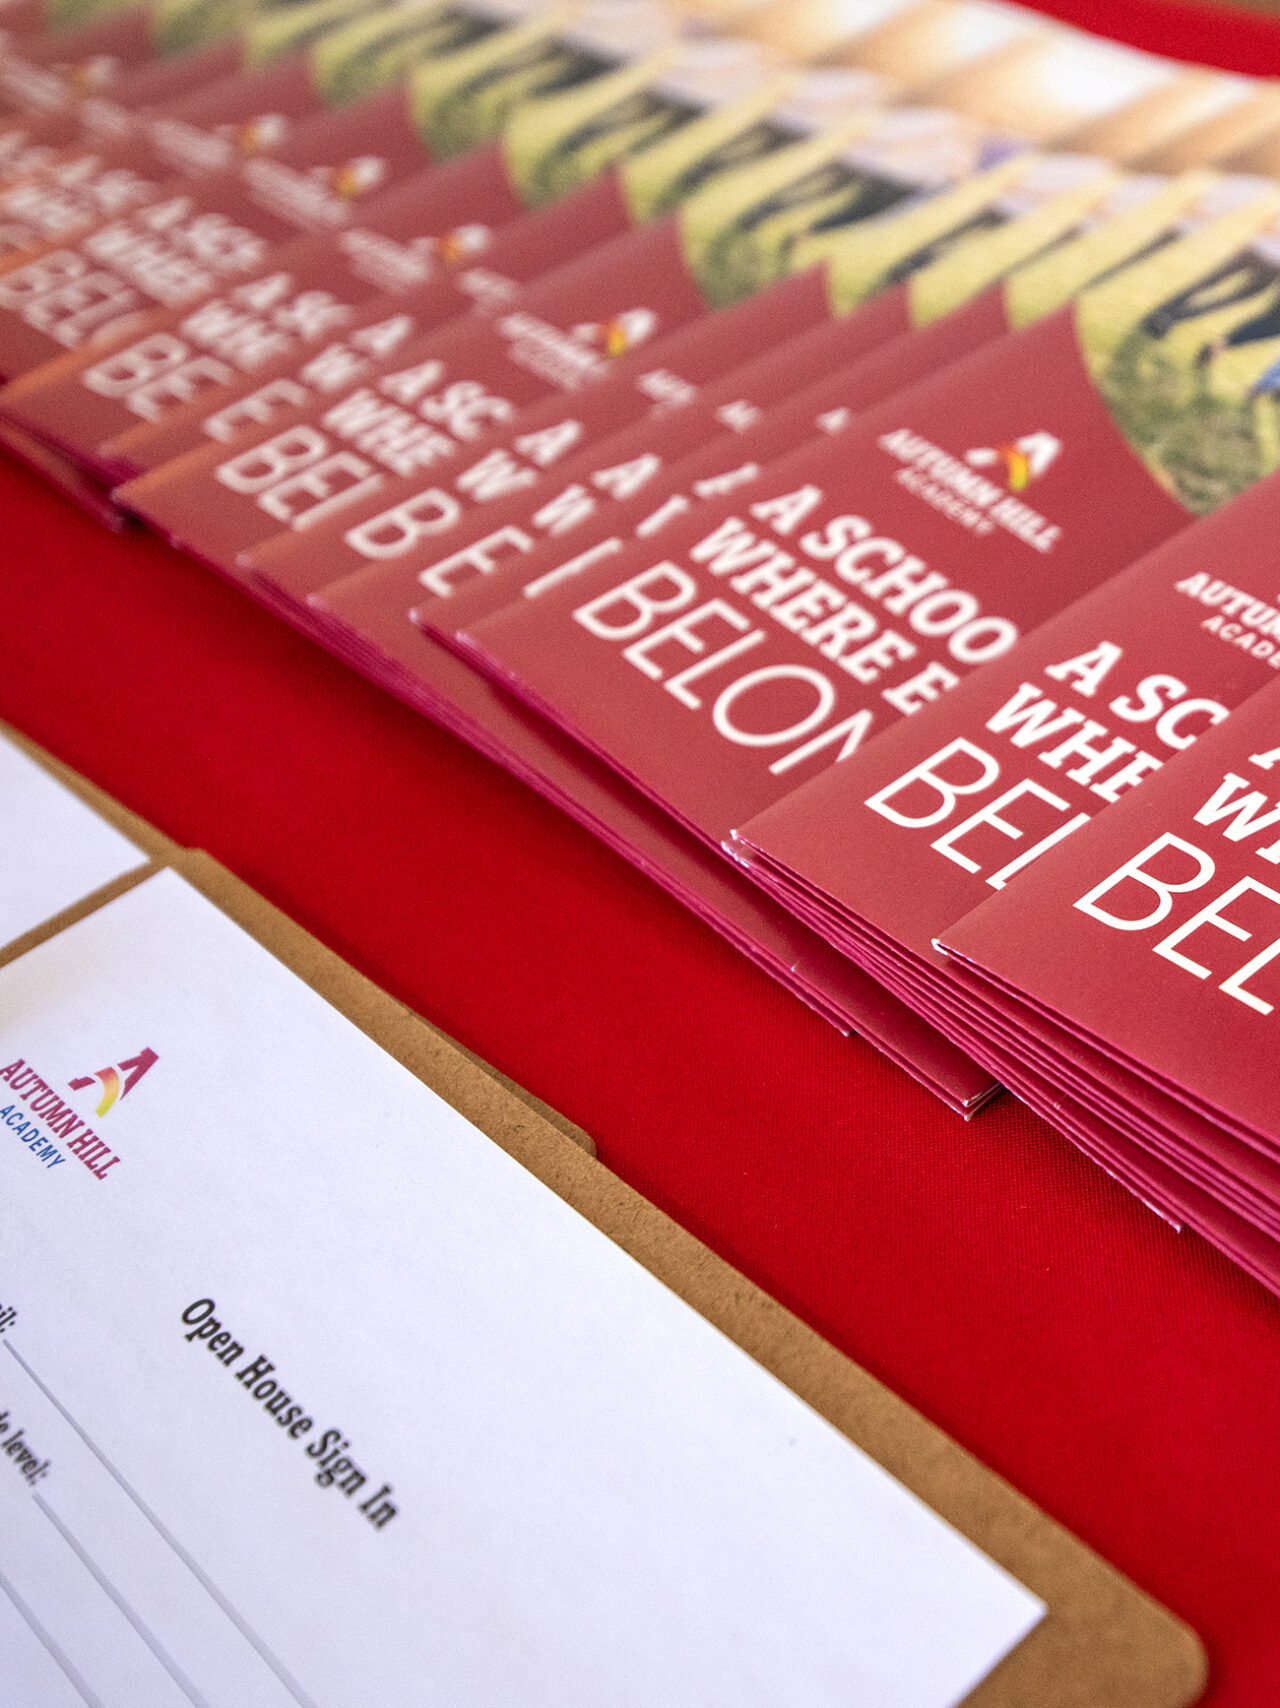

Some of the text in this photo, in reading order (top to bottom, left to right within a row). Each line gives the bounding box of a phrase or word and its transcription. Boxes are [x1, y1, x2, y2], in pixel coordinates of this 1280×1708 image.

[378, 359, 444, 404] A
[512, 418, 583, 467] A
[590, 452, 661, 500] A
[690, 516, 917, 684] WHERE
[750, 484, 822, 536] A
[799, 514, 1018, 664] SCHOO
[1044, 640, 1232, 751] A SC
[0, 1058, 121, 1181] AUTUMN HILL
[0, 1104, 66, 1169] ACADEMY
[181, 1297, 398, 1530] Open House Sign In
